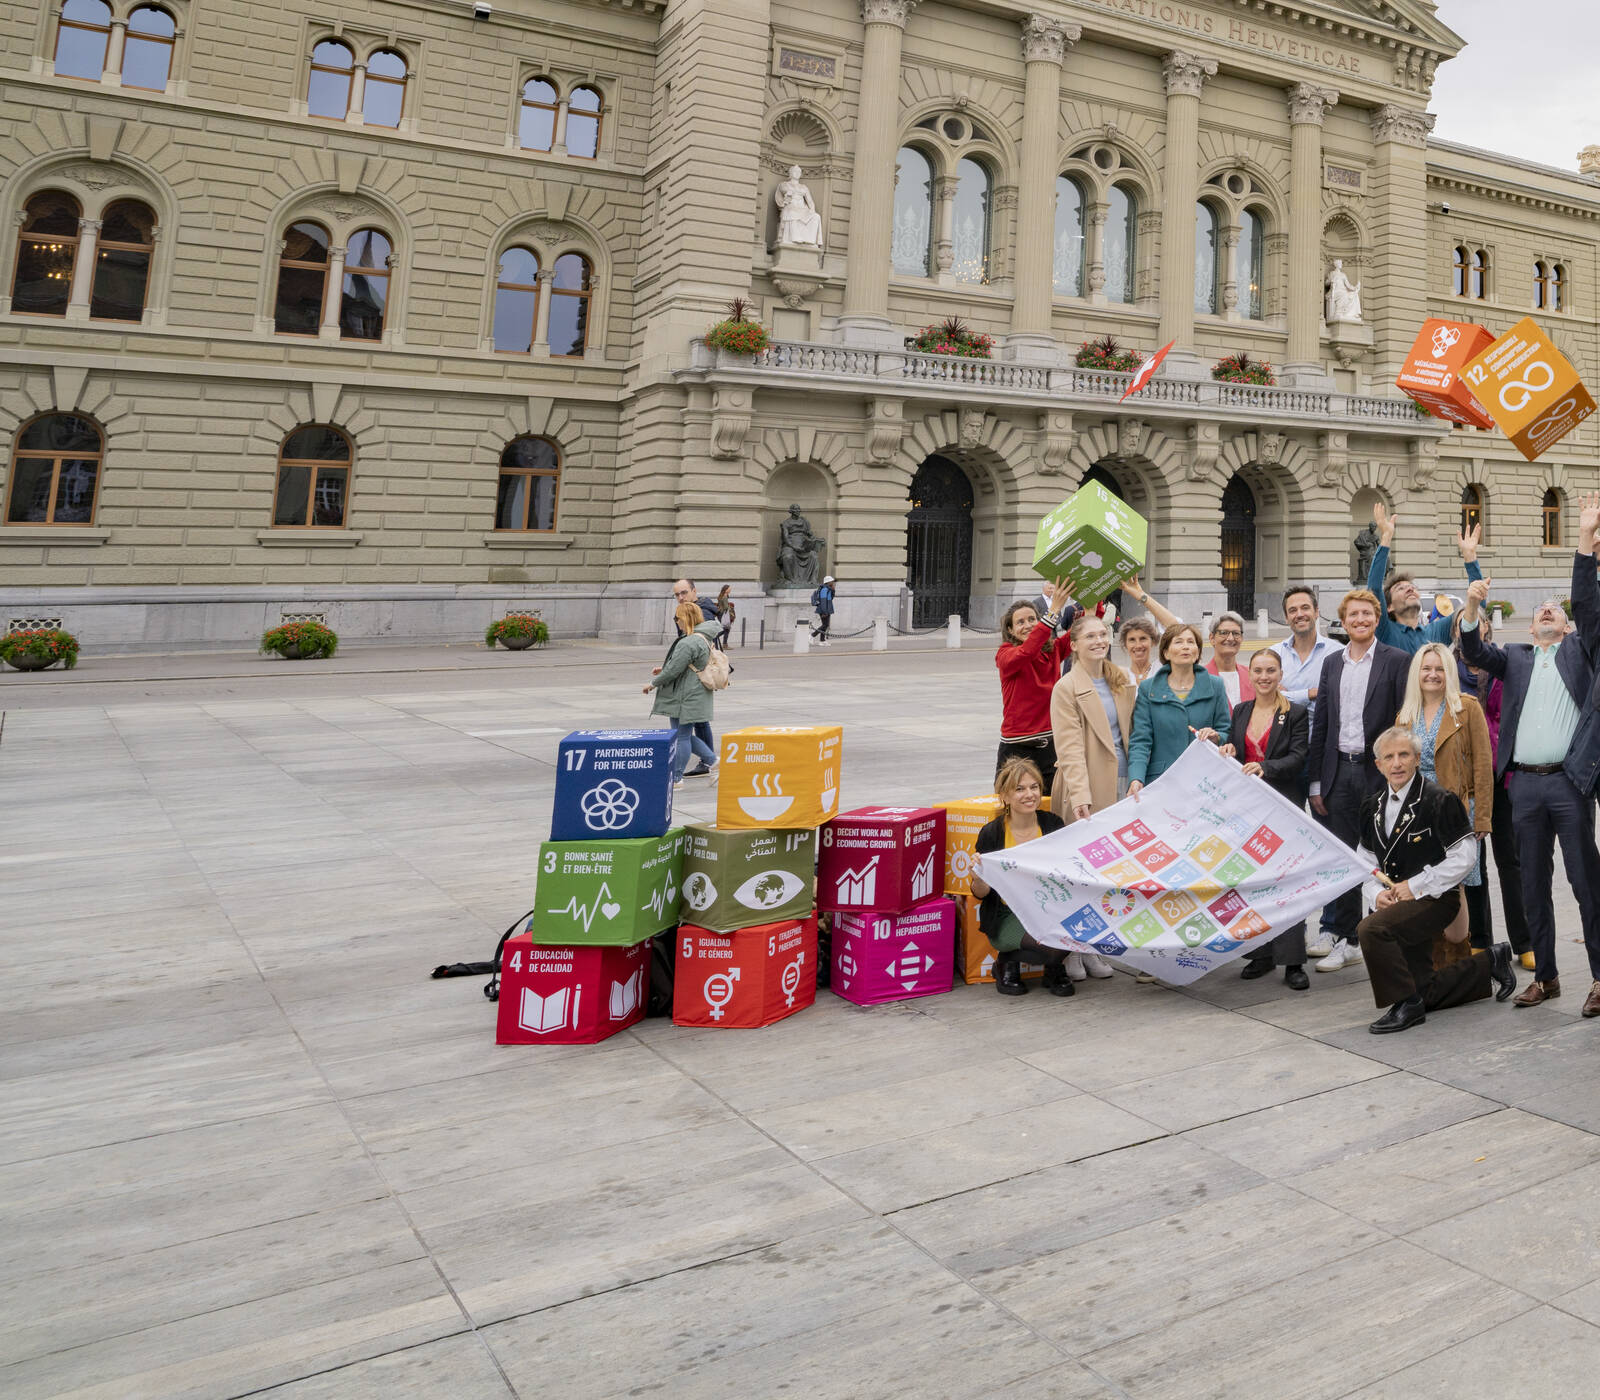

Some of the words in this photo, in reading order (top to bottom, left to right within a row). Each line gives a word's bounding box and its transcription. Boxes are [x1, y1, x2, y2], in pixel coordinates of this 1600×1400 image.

[1228, 19, 1360, 73] HELVETICAE
[1466, 364, 1488, 386] 12
[1096, 486, 1108, 502] 15
[564, 749, 586, 771] 17
[595, 747, 653, 758] PARTNERSHIPS
[726, 742, 738, 764] 2
[745, 742, 764, 752] ZERO
[745, 754, 775, 764] HUNGER
[594, 761, 609, 770] FOR
[611, 760, 626, 770] THE
[627, 760, 653, 770] GOALS
[684, 834, 693, 856] 13
[750, 836, 777, 849] العمل
[823, 827, 833, 848] 8
[837, 827, 859, 837] DECENT
[860, 828, 879, 837] WORK
[880, 828, 893, 838] AND
[837, 839, 869, 849] ECONOMIC
[869, 840, 896, 849] GROWTH
[904, 826, 911, 848] 8
[544, 851, 557, 874] 3
[565, 852, 589, 862] BONNE
[590, 850, 614, 862] SANTÉ
[563, 865, 572, 874] ET
[573, 863, 612, 874] BIEN-ÊTRE
[872, 919, 891, 940] 10
[896, 911, 943, 926] УМЕНЬШЕНИЕ
[895, 922, 942, 938] НЕРАВЕНСТВА
[683, 937, 693, 959] 5
[698, 938, 731, 952] IGUALDAD
[698, 949, 707, 959] DE
[708, 947, 733, 959] GÉNERO
[768, 936, 776, 957] 5
[509, 950, 522, 973] 4
[530, 947, 574, 960] EDUCACIÓN
[528, 963, 539, 973] DE
[540, 963, 573, 973] CALIDAD
